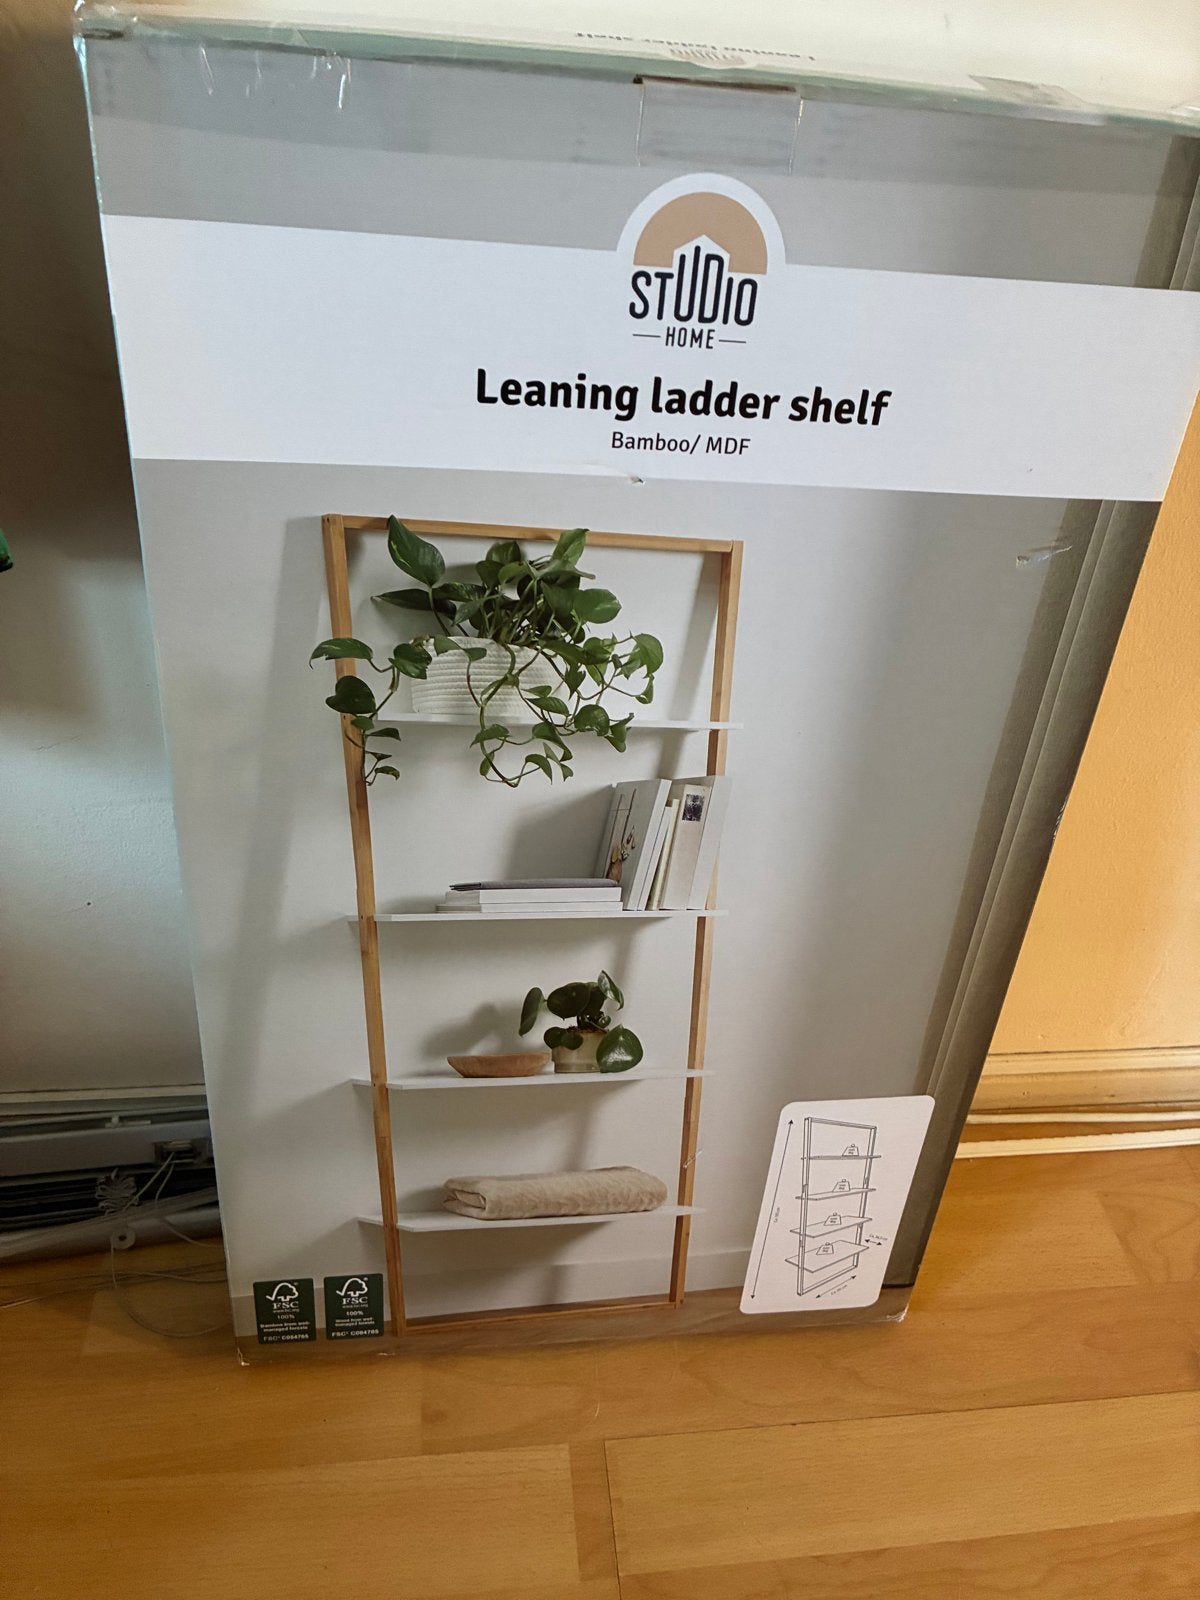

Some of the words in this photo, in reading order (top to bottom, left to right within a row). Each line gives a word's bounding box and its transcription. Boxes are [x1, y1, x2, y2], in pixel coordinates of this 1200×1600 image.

[629, 245, 758, 327] STUDIO
[665, 326, 717, 350] HOME
[476, 368, 639, 421] Leaning
[650, 376, 780, 421] ladder
[788, 385, 893, 426] shelf
[611, 431, 701, 455] Bamboo/
[705, 436, 751, 456] MDF
[272, 1301, 299, 1310] FSC
[342, 1296, 368, 1305] FSC
